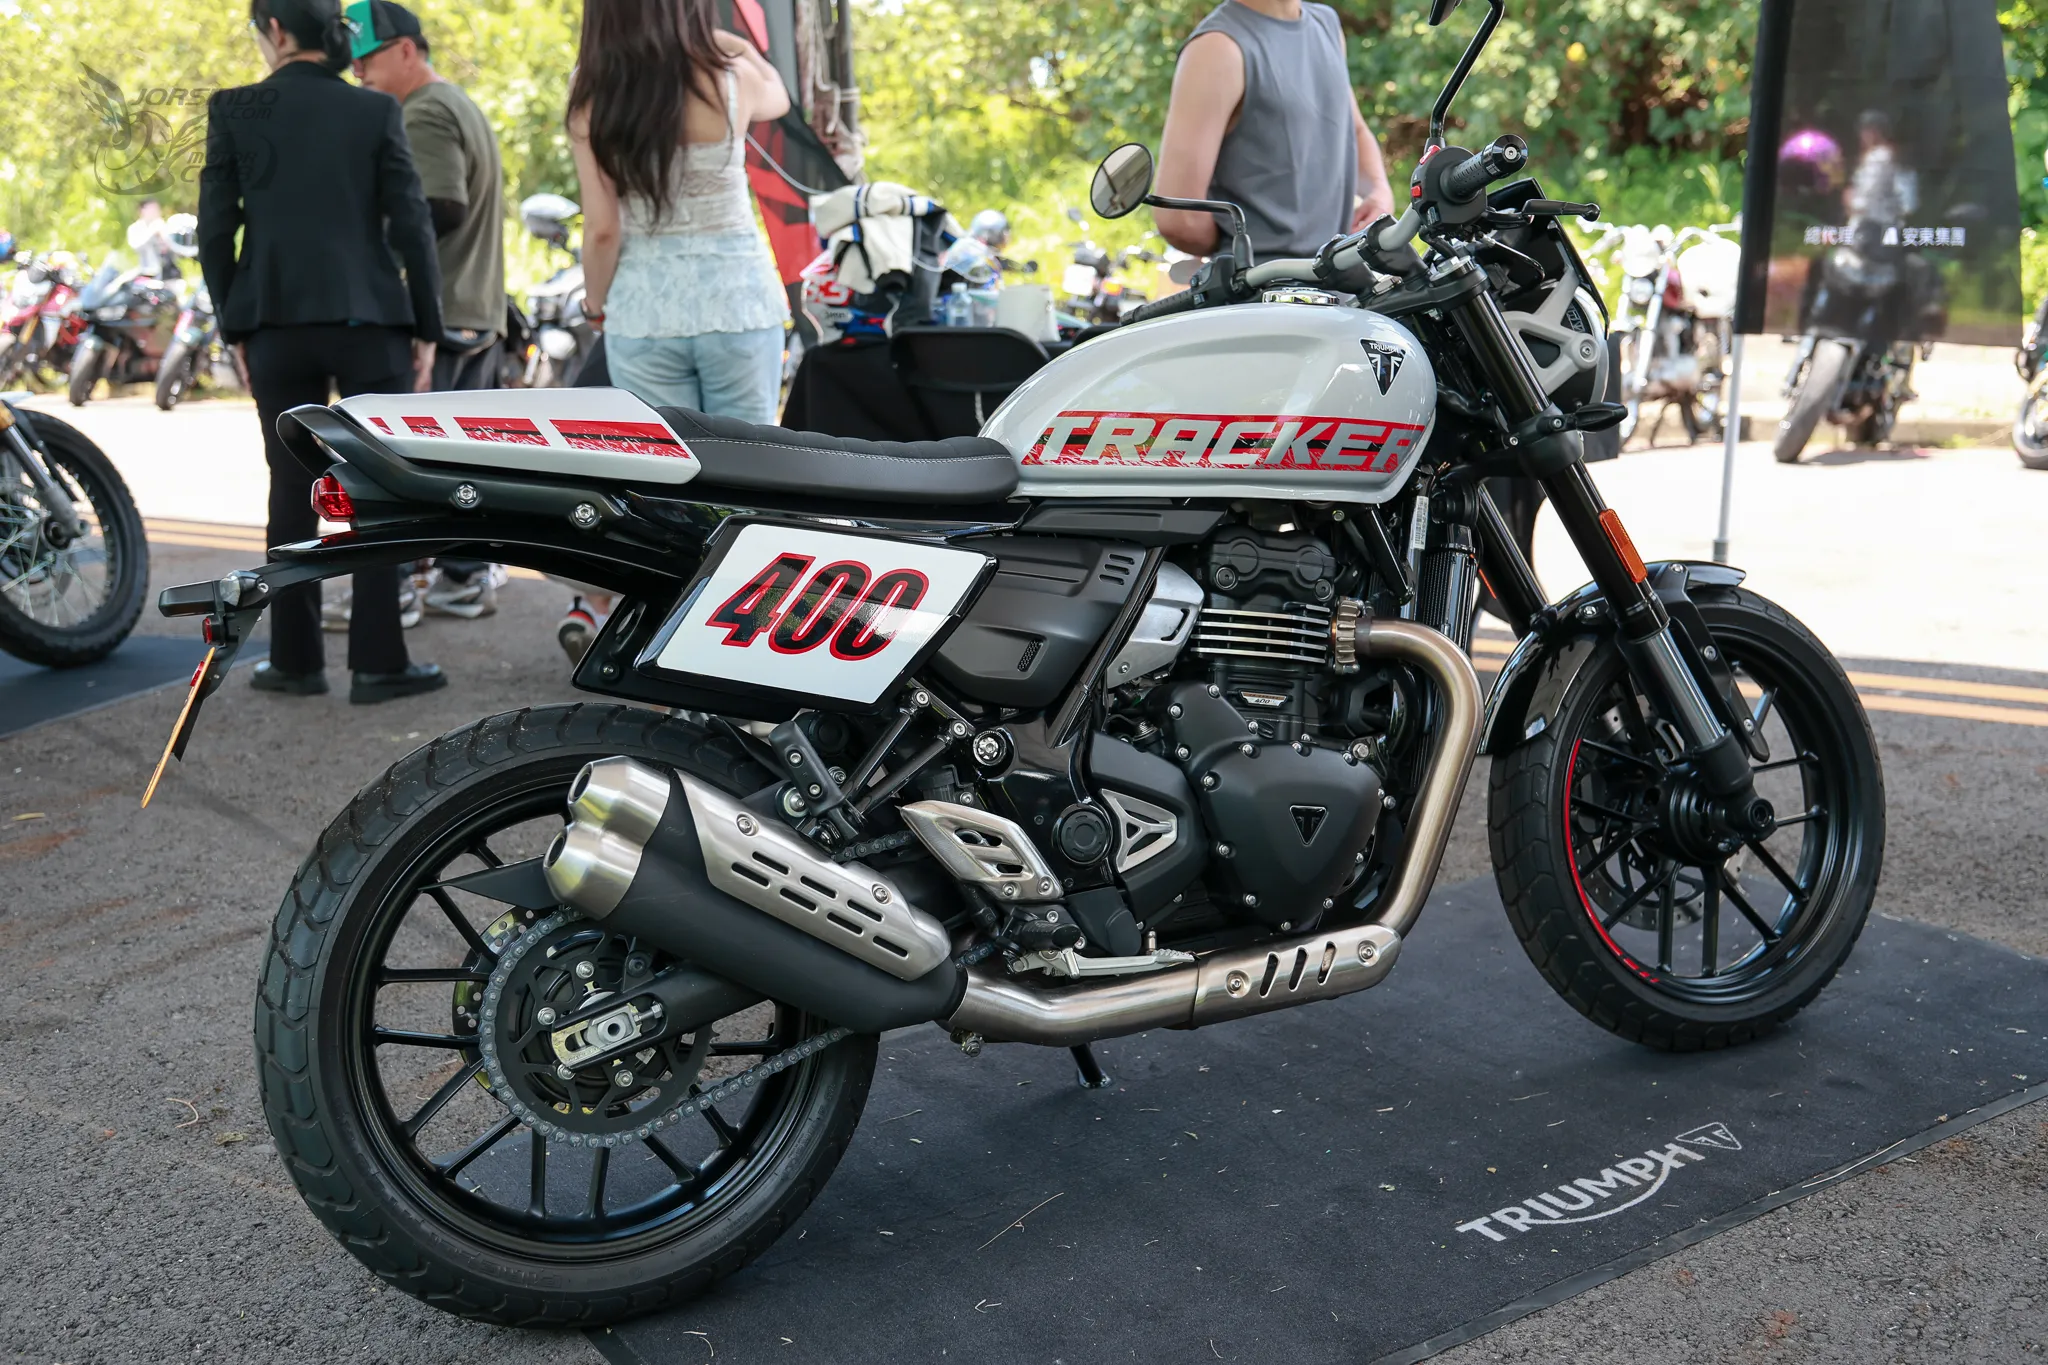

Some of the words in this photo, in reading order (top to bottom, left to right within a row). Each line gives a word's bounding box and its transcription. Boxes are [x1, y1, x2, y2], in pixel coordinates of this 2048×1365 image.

[1369, 342, 1399, 354] TRIUMPH
[1038, 415, 1424, 471] TRACKER
[705, 552, 930, 662] 400
[1455, 1142, 1706, 1242] TRIUMPH
